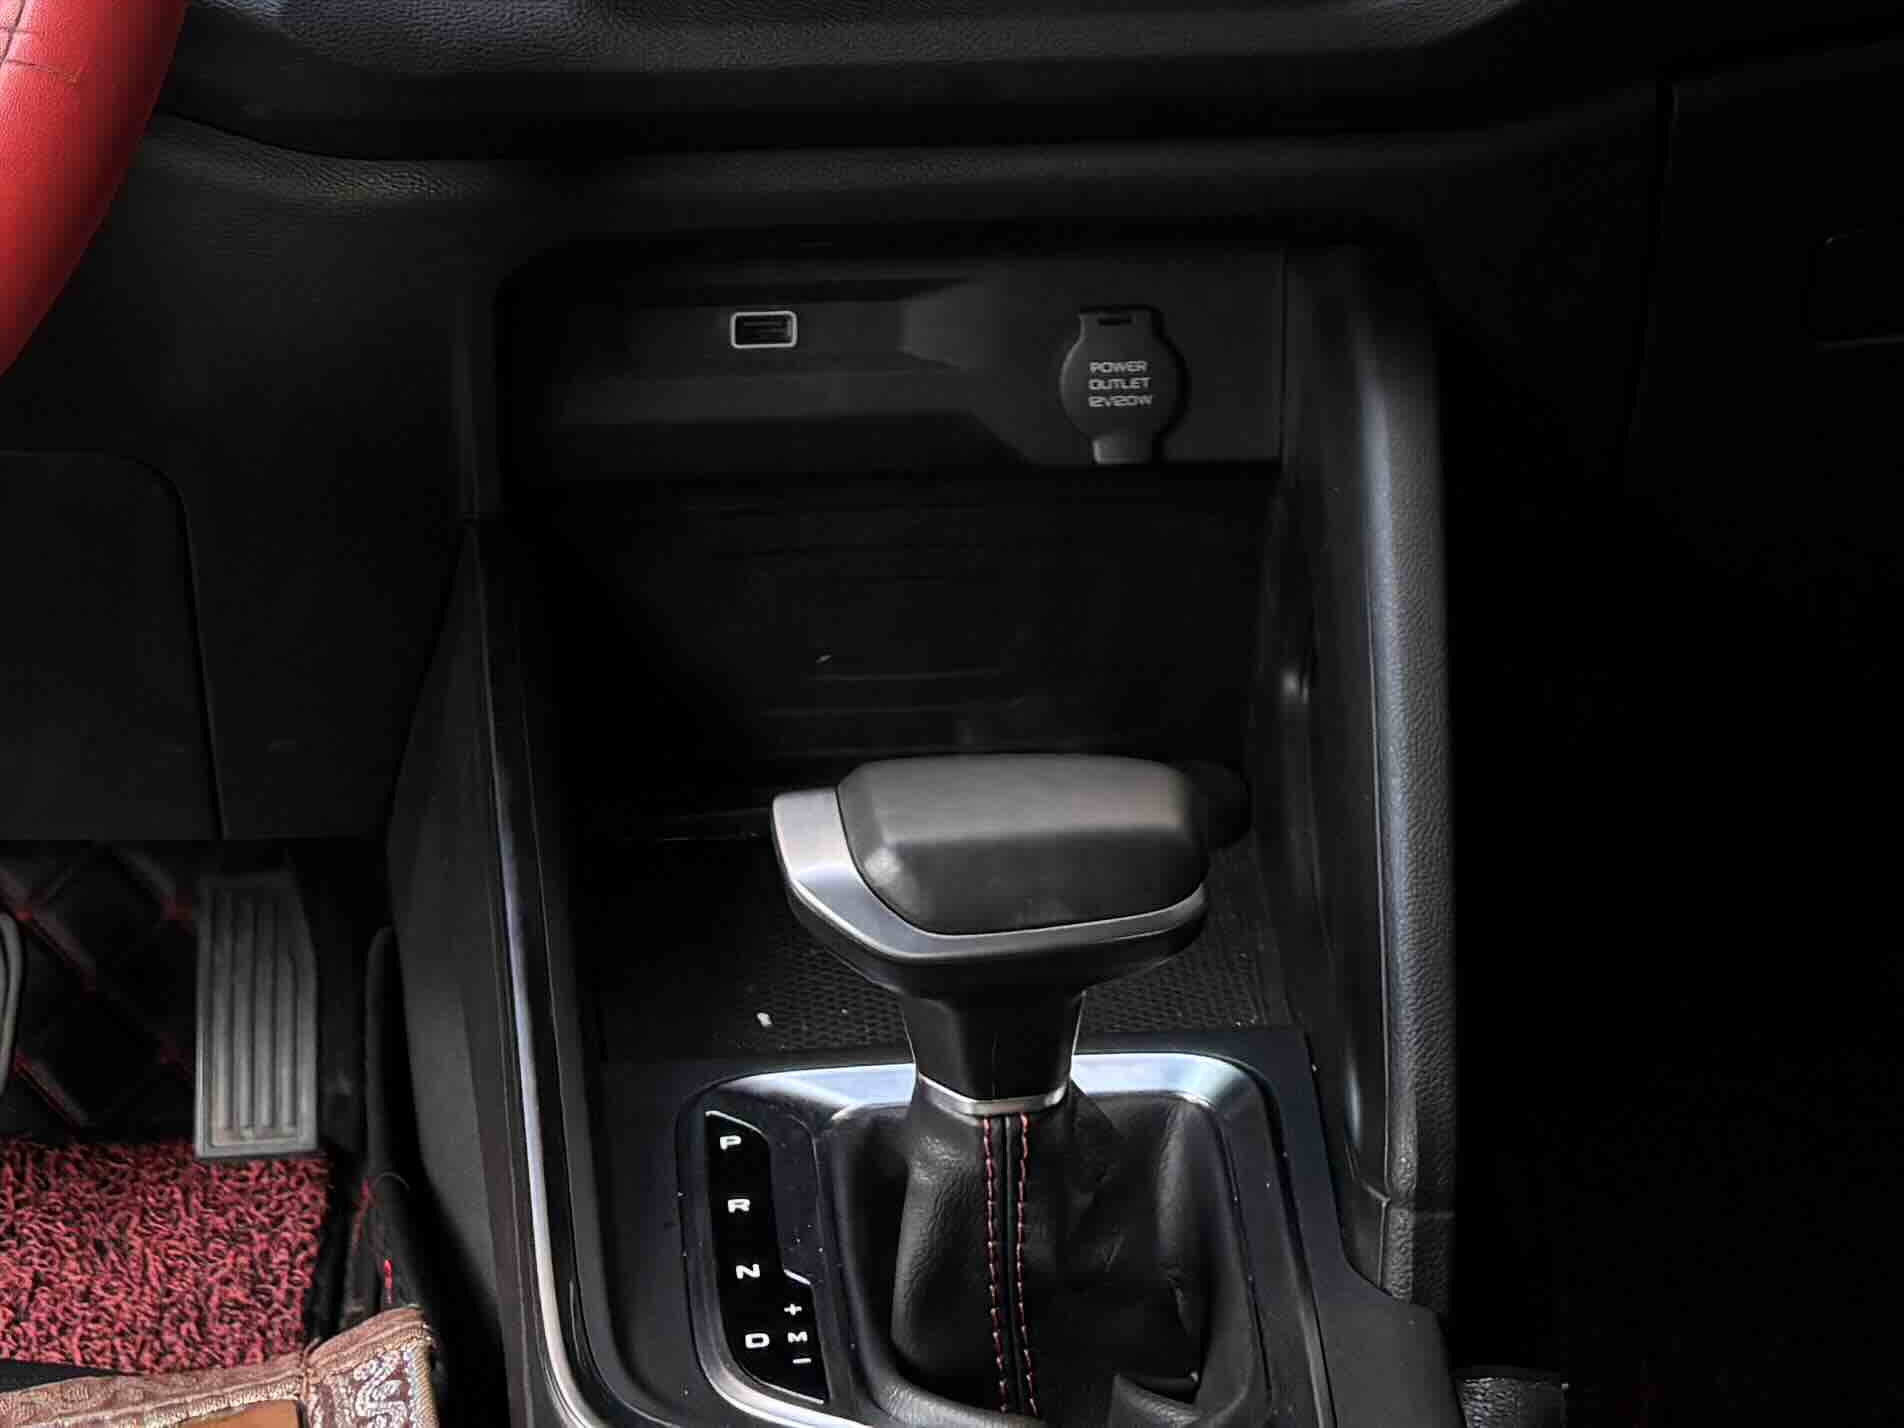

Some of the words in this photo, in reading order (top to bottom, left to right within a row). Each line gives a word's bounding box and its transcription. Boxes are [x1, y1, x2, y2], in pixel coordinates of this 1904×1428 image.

[1089, 360, 1148, 374] POWER
[1088, 377, 1153, 390] OUTLET
[719, 1135, 741, 1151] P
[727, 1199, 750, 1214] R
[735, 1263, 761, 1280] N
[745, 1332, 770, 1350] D
[788, 1331, 808, 1343] M
